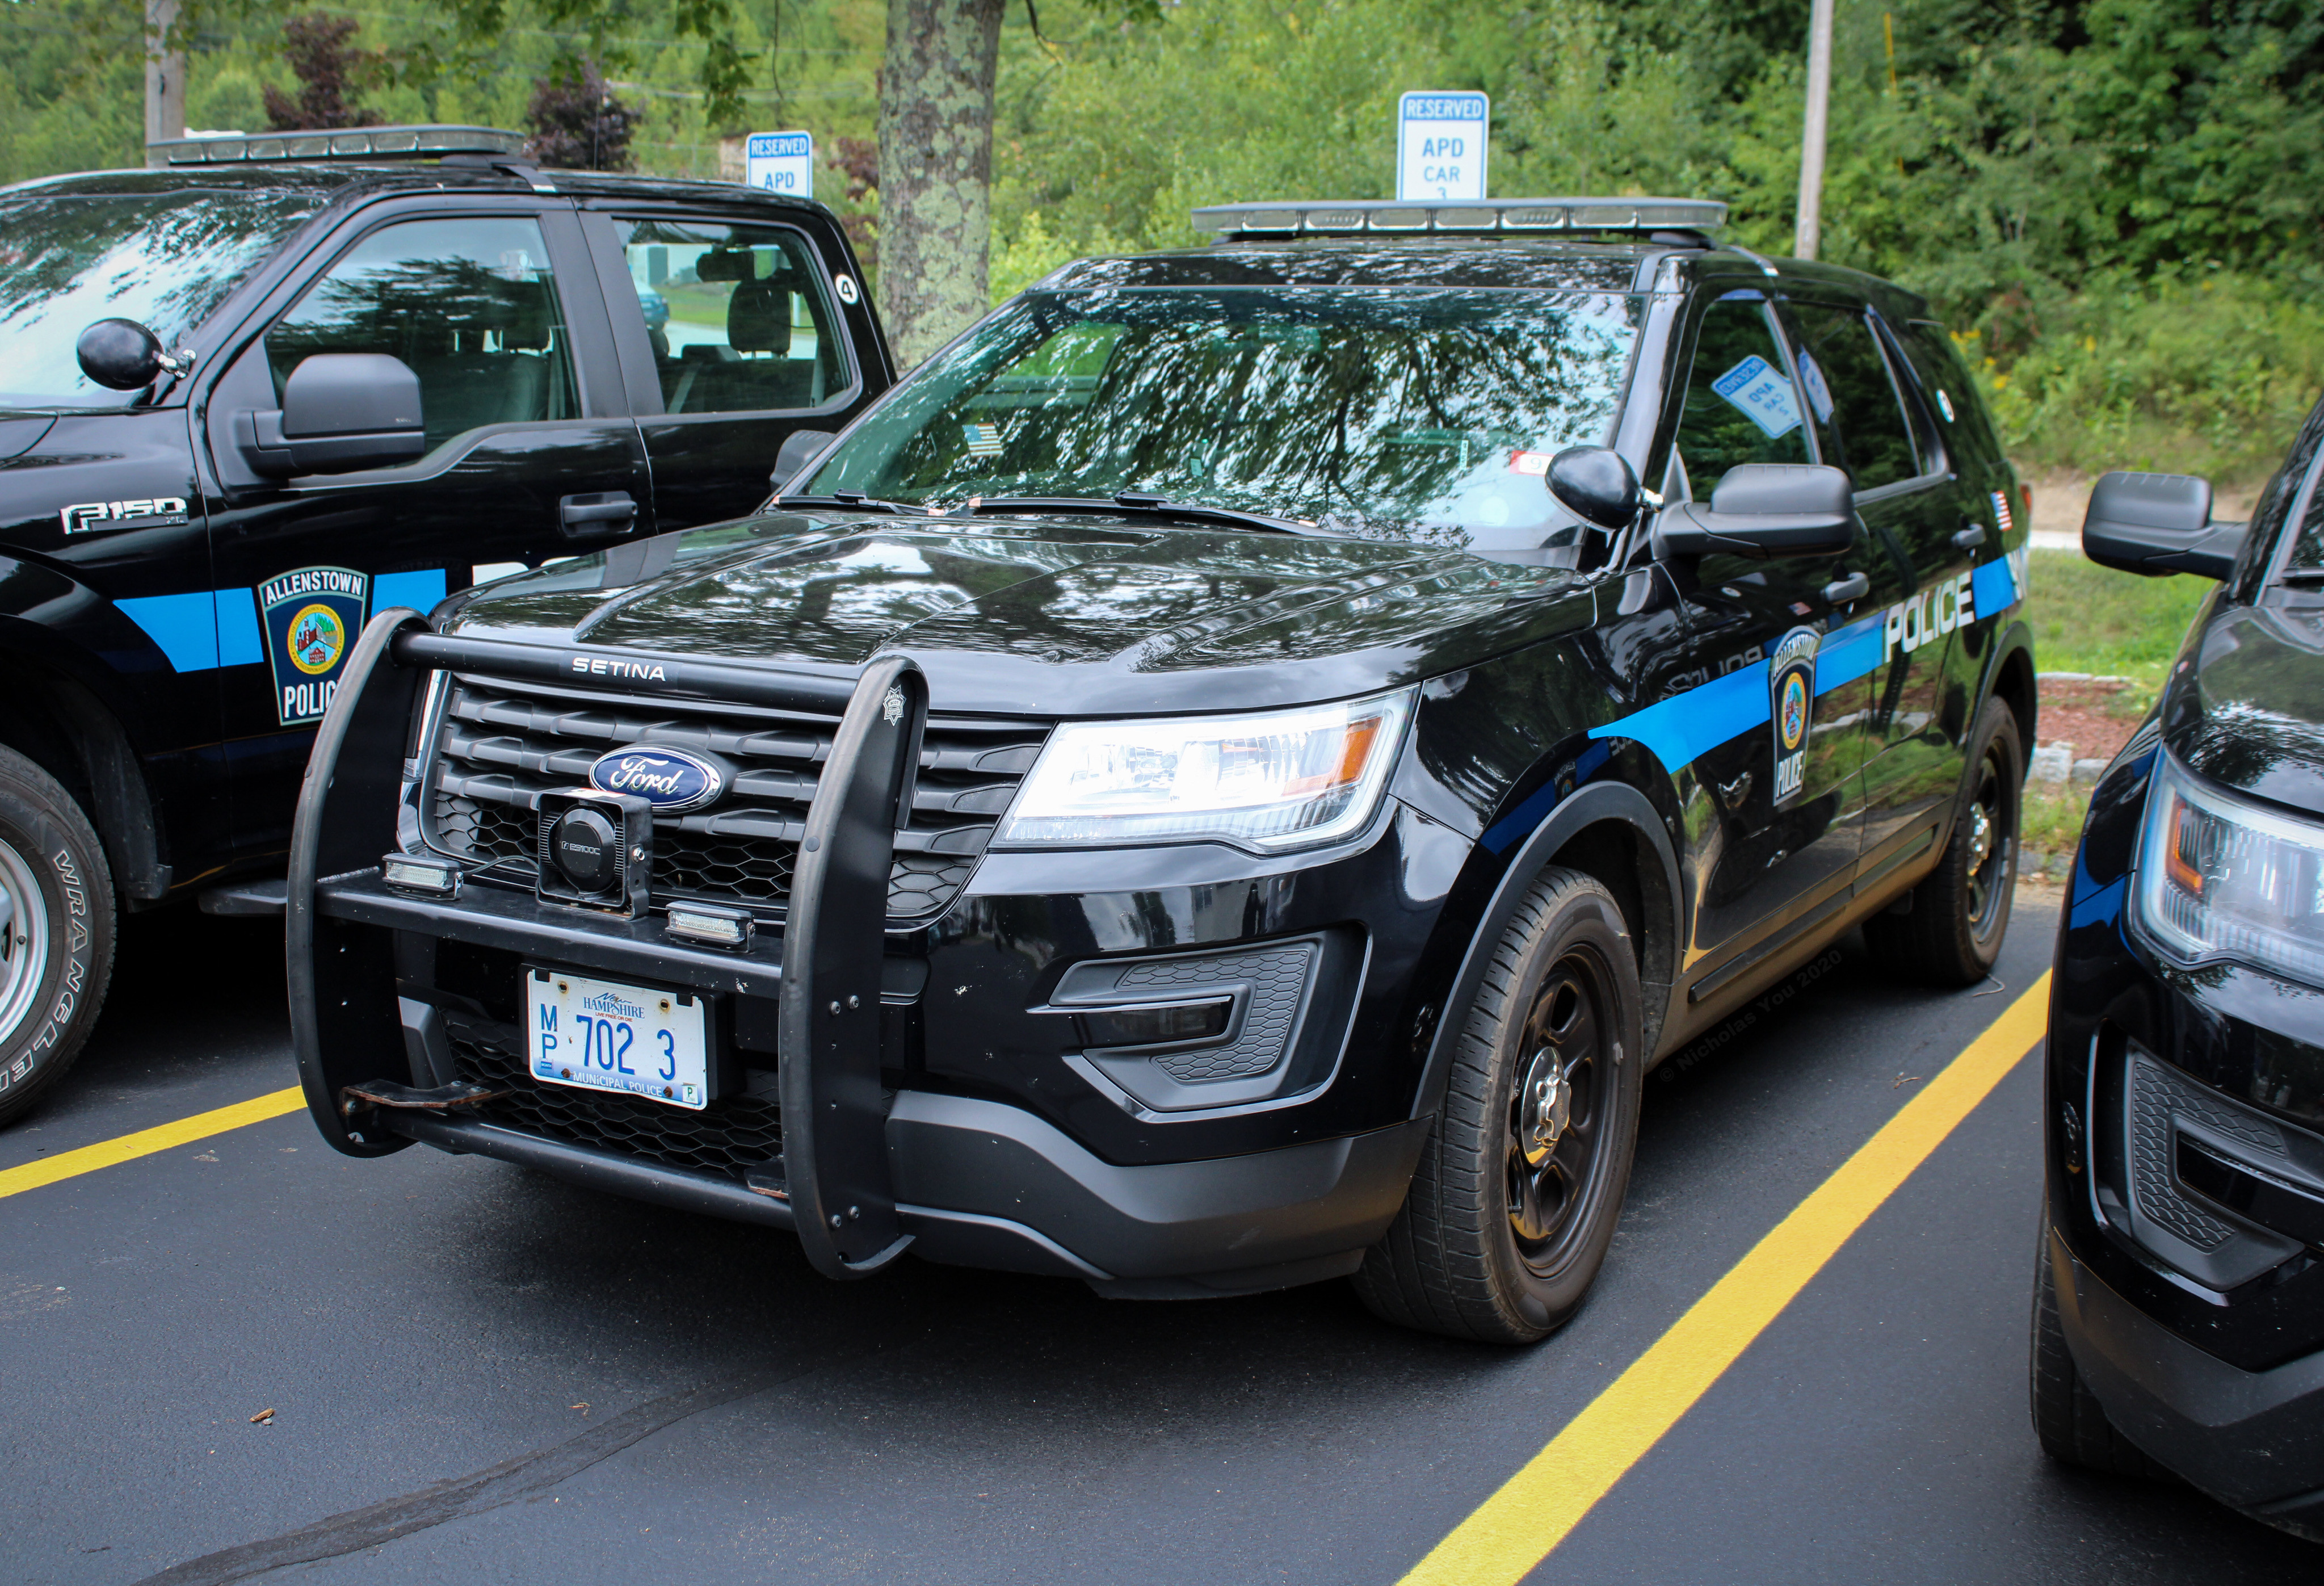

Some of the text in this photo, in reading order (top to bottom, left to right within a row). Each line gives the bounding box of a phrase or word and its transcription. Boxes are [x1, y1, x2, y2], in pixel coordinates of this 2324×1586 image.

[1406, 99, 1482, 119] RESERVED
[751, 138, 807, 156] RESERVED
[1422, 137, 1464, 157] APD
[764, 171, 795, 189] APD
[1424, 166, 1460, 182] CAR
[842, 280, 853, 299] 4
[266, 570, 363, 605] ALLENSTOWN
[1884, 570, 1976, 664] POLICE
[1773, 633, 1818, 678] ALLENSTOWN
[572, 657, 666, 682] SETINA
[284, 679, 339, 719] POLIC
[610, 755, 684, 794] Ford
[1776, 750, 1804, 798] POLICE
[569, 843, 600, 856] ES100C
[583, 997, 645, 1019] HAMPSHIRE
[594, 992, 633, 1004] New
[576, 1014, 636, 1075] 702
[657, 1029, 677, 1081] 3
[628, 1081, 662, 1097] POLICE
[687, 1086, 693, 1097] P
